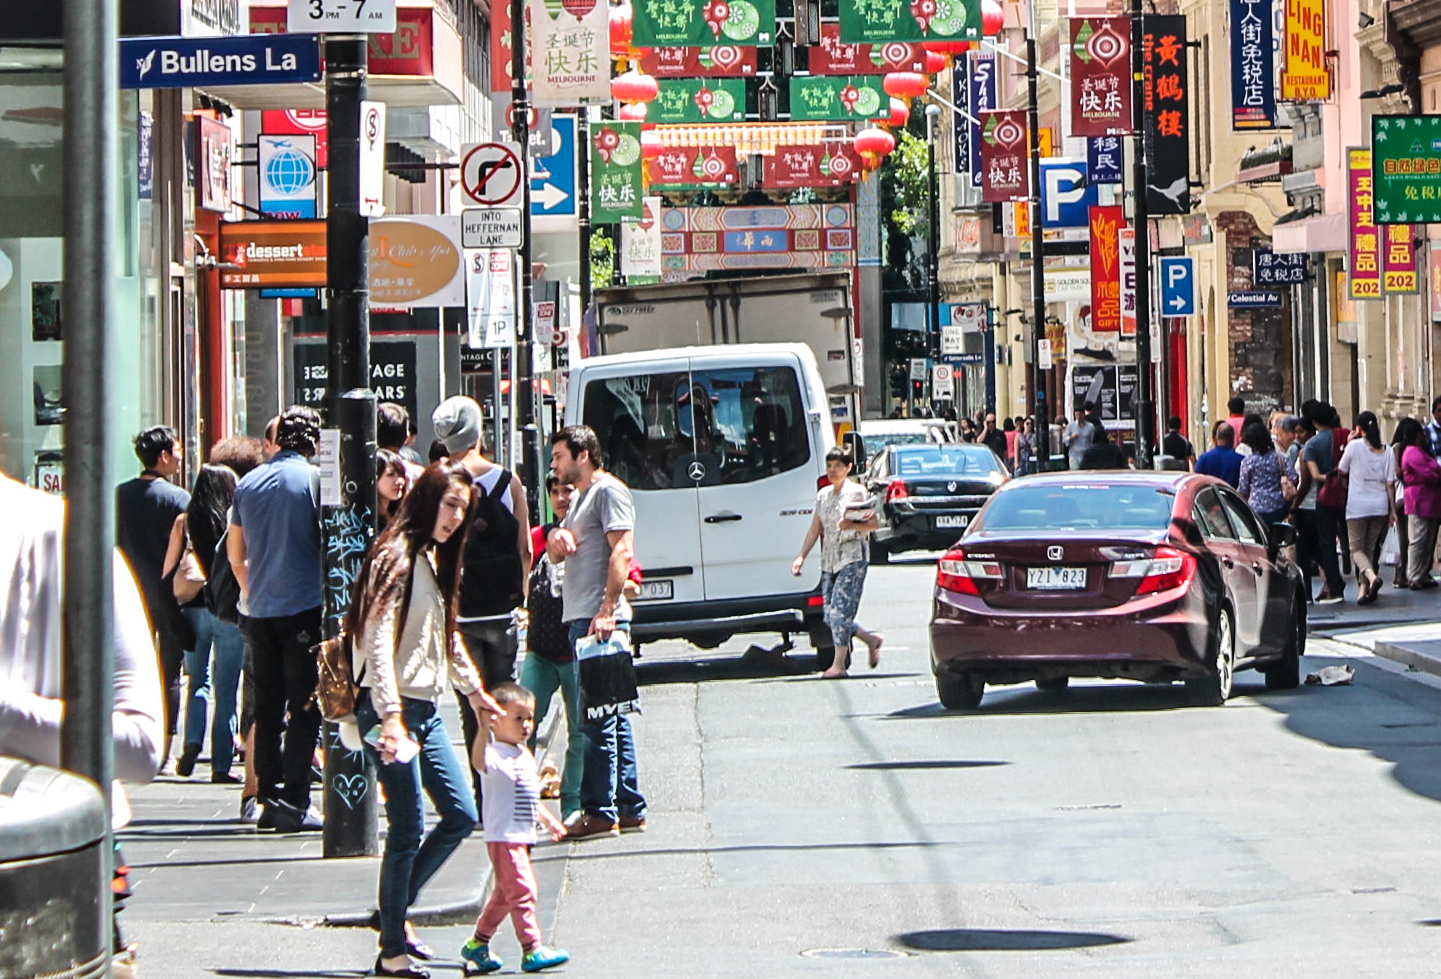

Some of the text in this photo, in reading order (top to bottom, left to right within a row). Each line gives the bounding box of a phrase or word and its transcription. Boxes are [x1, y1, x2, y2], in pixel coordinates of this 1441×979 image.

[546, 31, 595, 49] 圣诞节
[1291, 33, 1320, 69] NAN
[161, 48, 297, 73] Bullens La
[545, 49, 599, 75] 快乐
[547, 75, 596, 83] MELBOURNE
[1081, 76, 1119, 91] 圣诞节
[1144, 65, 1154, 111] crane
[1080, 91, 1122, 112] 快乐
[1093, 136, 1118, 170] 移民
[988, 167, 1022, 184] 快乐
[599, 184, 636, 202] 快乐
[1046, 169, 1085, 222] P
[481, 212, 501, 221] INTO
[466, 223, 519, 232] HEFFERNAN
[480, 235, 503, 245] LANE
[247, 242, 303, 258] dessert
[1168, 265, 1187, 288] P
[1387, 276, 1413, 287] 202
[1354, 283, 1379, 294] 202
[1231, 294, 1278, 303] Celestial Av
[493, 321, 506, 335] 1P
[1063, 569, 1084, 583] 823
[651, 580, 671, 595] 037
